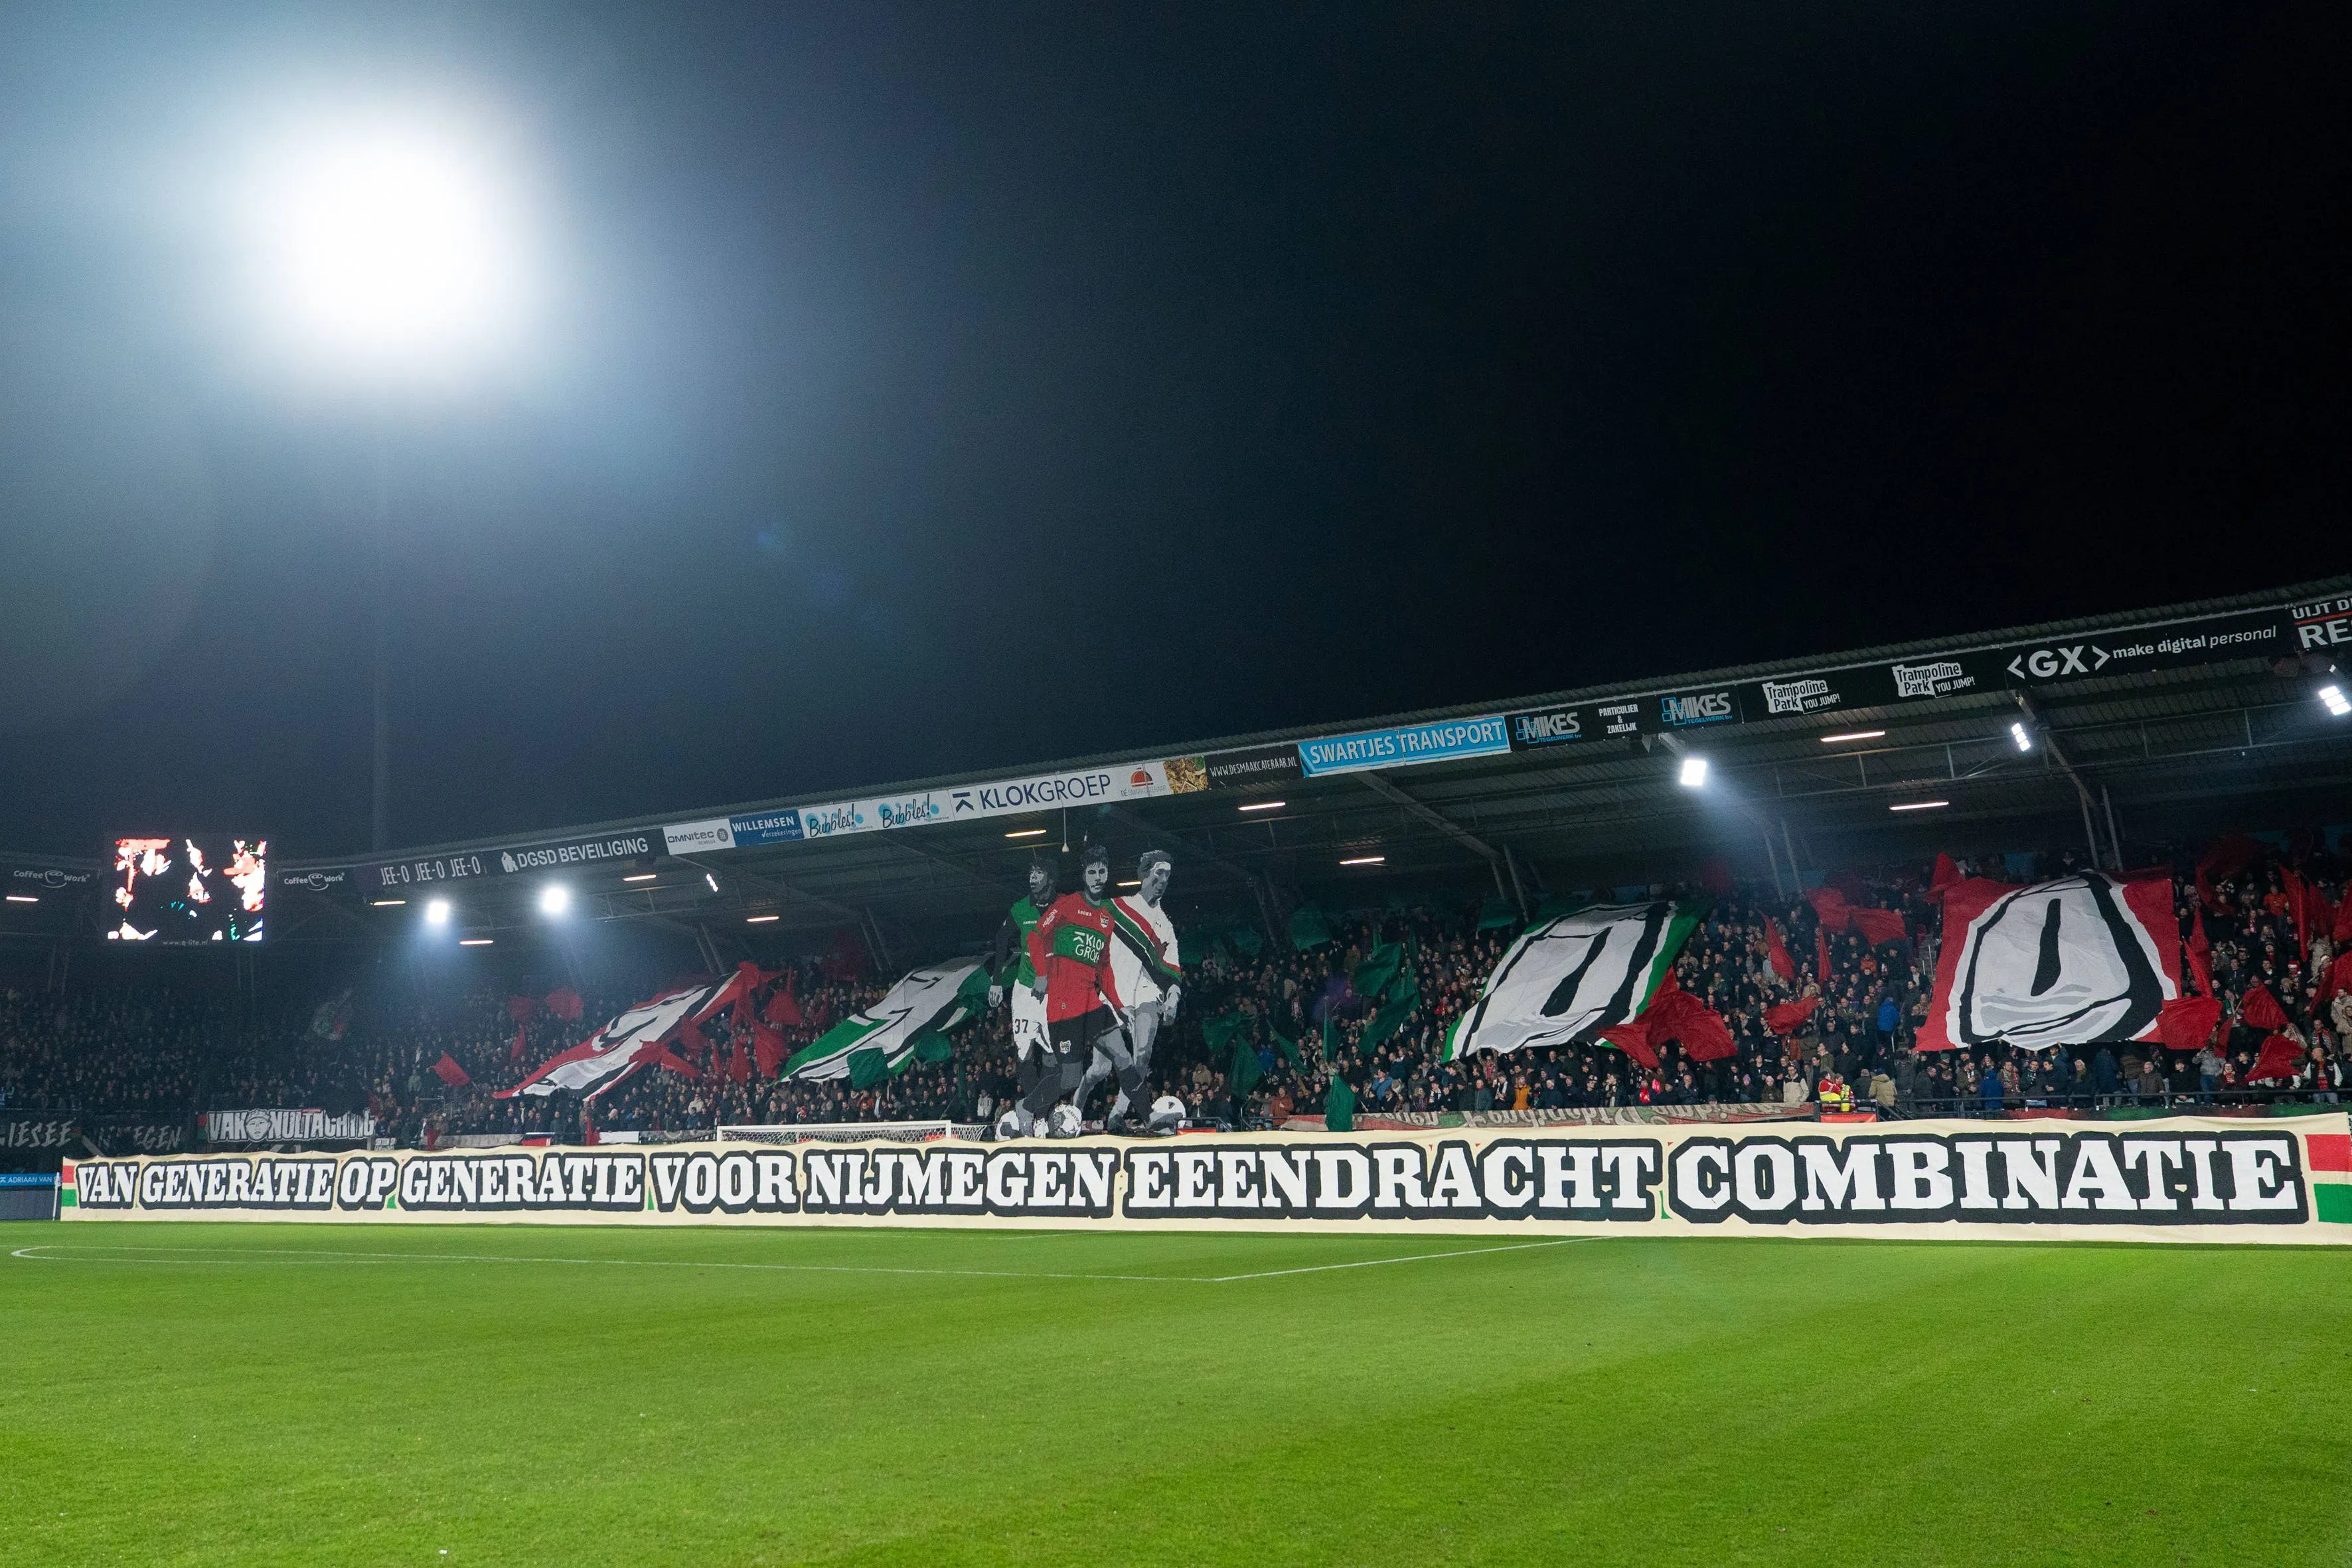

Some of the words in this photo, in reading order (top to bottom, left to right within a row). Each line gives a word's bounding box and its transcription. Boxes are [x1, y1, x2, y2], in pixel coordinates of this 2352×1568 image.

[2337, 598, 2352, 611] D
[2112, 643, 2154, 659] make
[2157, 635, 2207, 654] digital
[2210, 625, 2276, 649] personal
[2298, 619, 2352, 649] RE
[1897, 663, 1961, 682] Trampoline
[1766, 680, 1827, 700] Trampoline
[1903, 678, 1930, 695] Park
[1935, 680, 1951, 692] YOU
[1952, 676, 1974, 690] JUMP!
[1599, 704, 1638, 717] PARTICULIER
[1669, 693, 1731, 720] MIKES
[1774, 696, 1800, 712] Park
[1803, 699, 1818, 710] YOU
[1819, 694, 1840, 707] JUMP!
[1523, 712, 1581, 739] MIKES
[1607, 722, 1637, 734] ZAKELIJK
[1618, 714, 1623, 724] &
[1687, 714, 1724, 725] TEGELWERK
[1310, 736, 1395, 764] SWARTJES
[1396, 721, 1503, 753] TRANSPORT
[1539, 734, 1574, 744] TEGELWERK
[1210, 756, 1298, 777] WWW.DESMAAKCATERAAR.NL
[979, 773, 1111, 810] KLOKGROEP
[809, 803, 854, 838] Bubbles!
[882, 793, 930, 828] Bubbles!
[732, 816, 795, 832] WILLEMSEN
[558, 837, 649, 863] BEVEILIGING
[13, 870, 43, 879] Coffee
[1014, 1018, 1029, 1034] 37
[208, 1111, 246, 1142] VAK
[76, 1161, 138, 1204] VAN
[141, 1160, 334, 1204] GENERATIE
[340, 1160, 397, 1204] OP
[401, 1156, 642, 1204] GENERATIE
[653, 1153, 796, 1206] VOOR
[805, 1151, 1119, 1208] NIJMEGEN
[1127, 1144, 1656, 1210] EEENDRACHT
[1676, 1138, 2300, 1212] COMBINATIE
